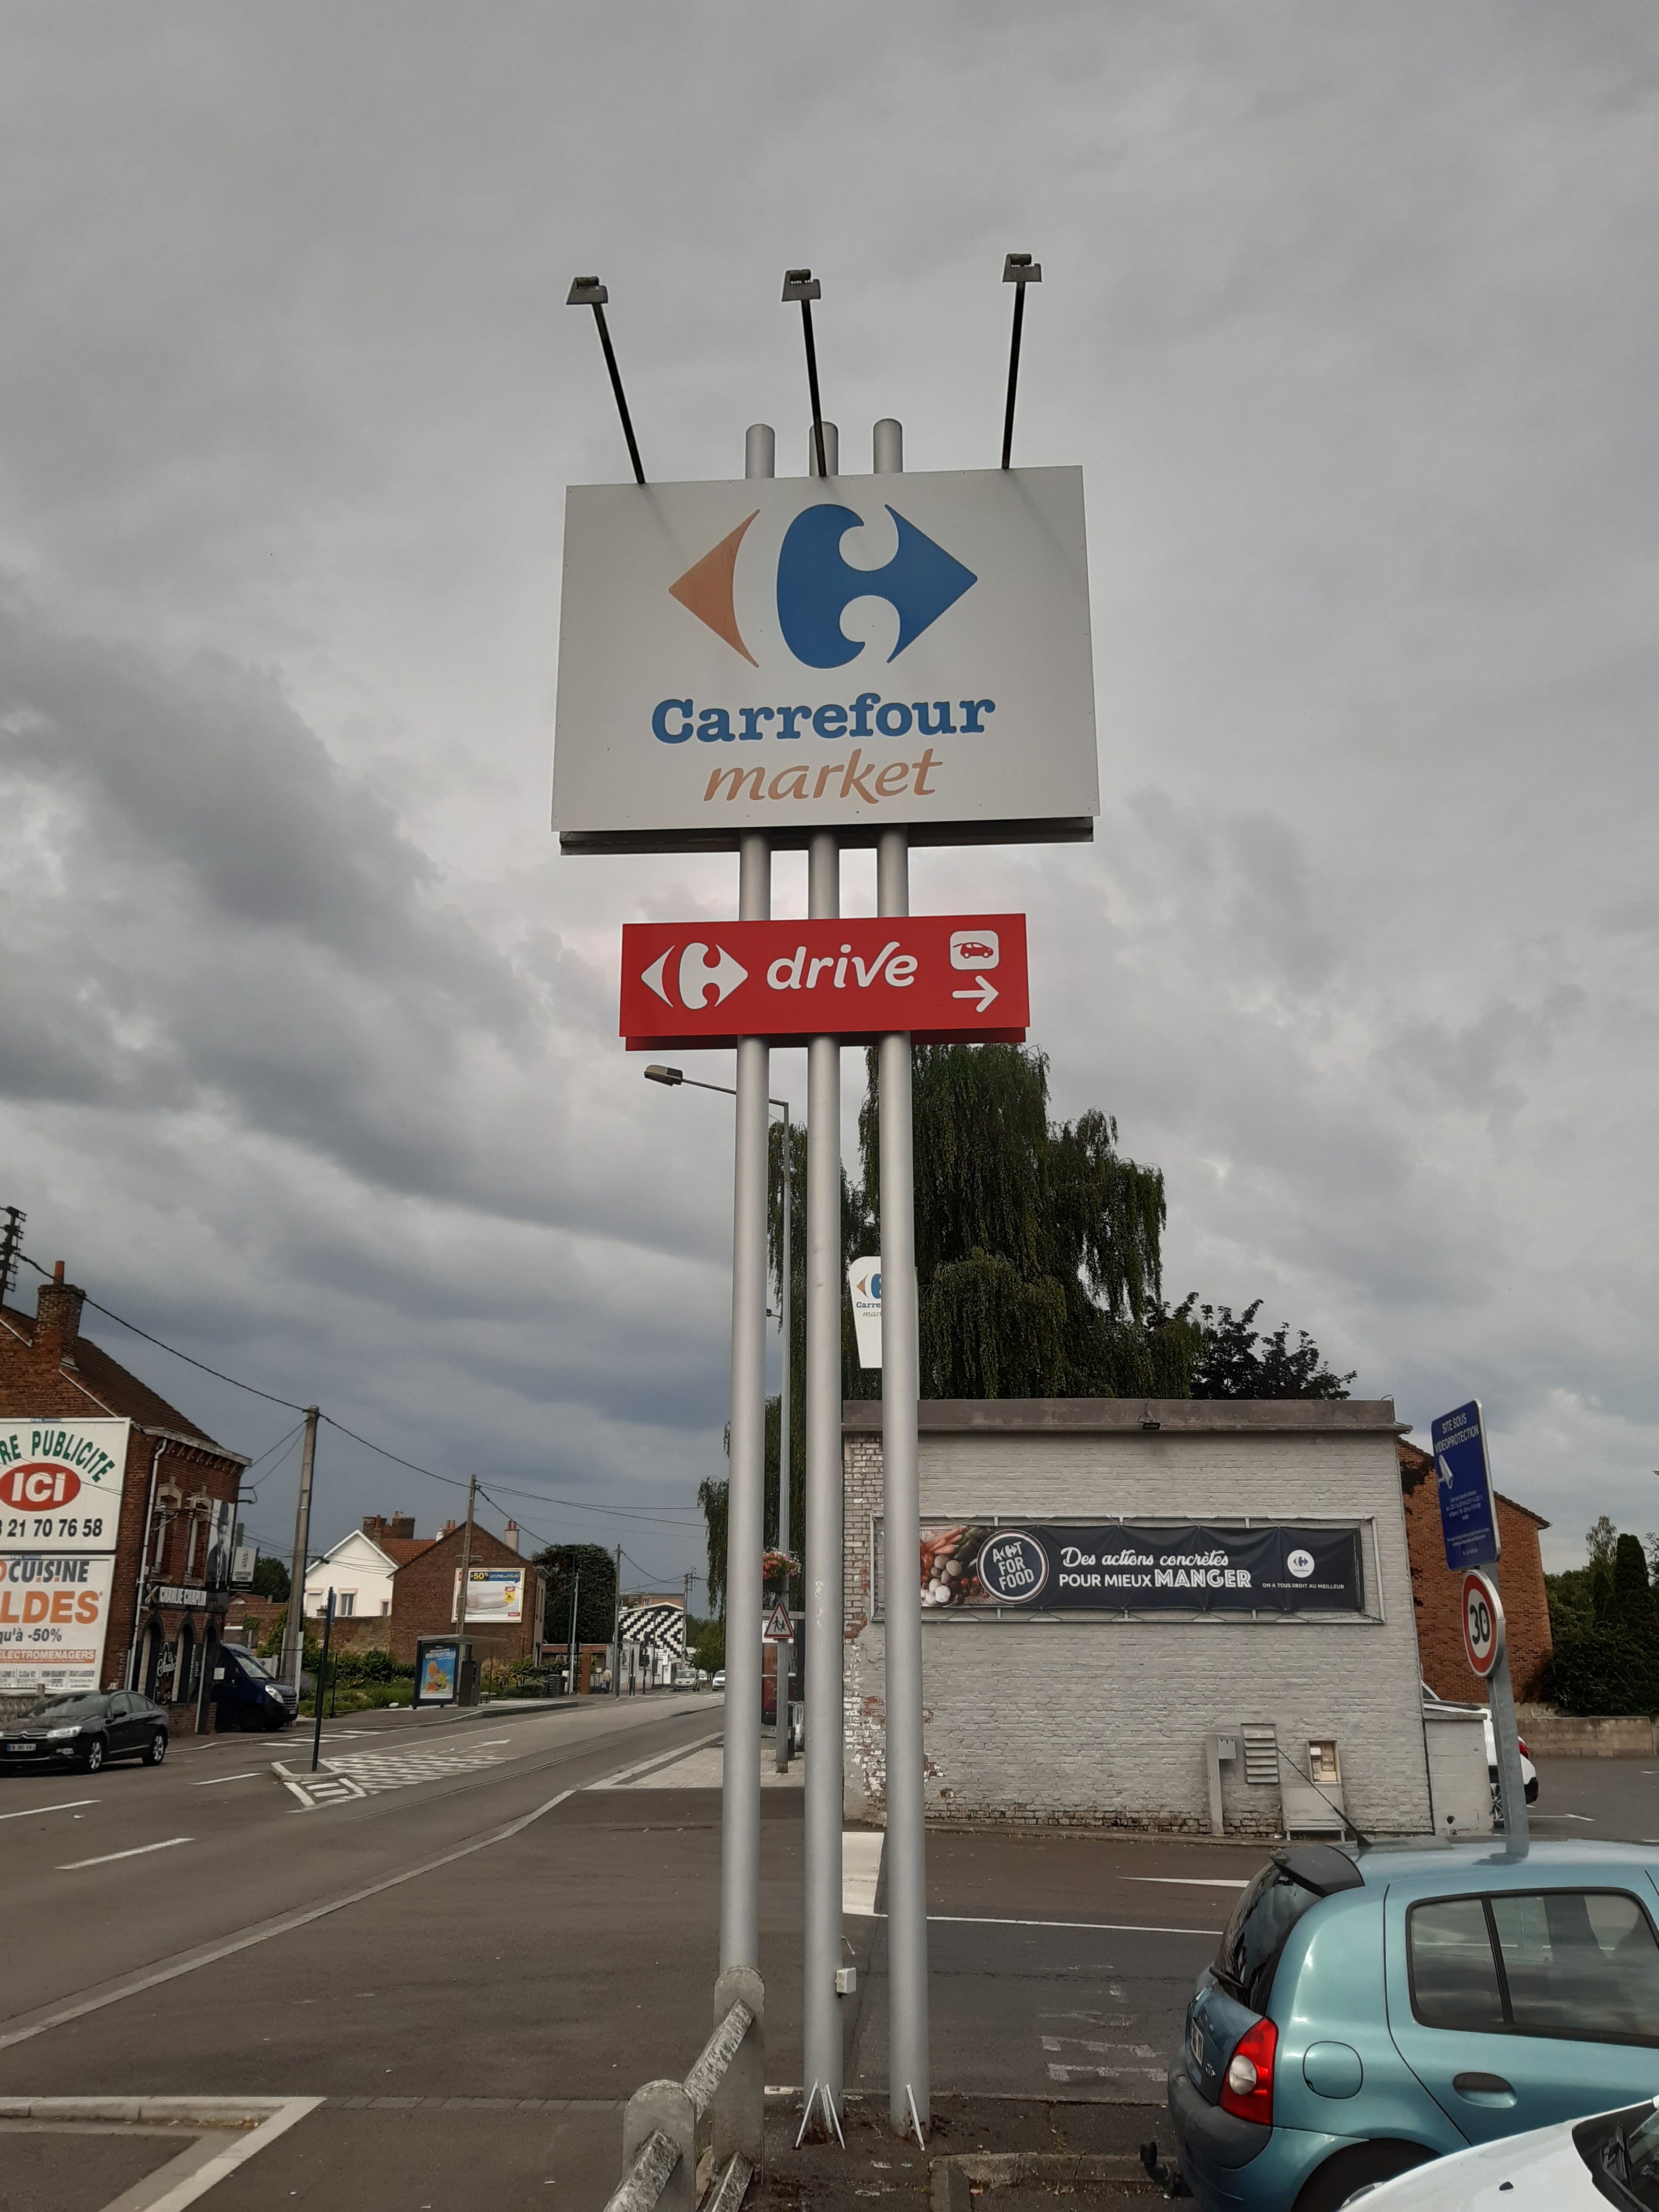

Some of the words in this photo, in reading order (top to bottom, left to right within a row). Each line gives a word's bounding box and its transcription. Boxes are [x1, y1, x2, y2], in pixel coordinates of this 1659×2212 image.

[652, 693, 995, 744] Carrefour
[704, 748, 942, 804] market
[767, 941, 918, 989] drive
[1442, 1419, 1453, 1434] SITE
[1453, 1413, 1467, 1429] SOUS
[1434, 1424, 1479, 1454] VIDEOPROTECTION
[32, 1430, 115, 1483] PUBLICITE
[11, 1472, 66, 1502] ICI
[7, 1518, 26, 1537] 21
[33, 1518, 52, 1537] 70
[58, 1518, 78, 1537] 76
[82, 1518, 103, 1537] 58
[998, 1556, 1026, 1575] FOR
[1060, 1547, 1096, 1567] Des
[1102, 1549, 1154, 1566] actions
[1159, 1550, 1229, 1566] concrètes
[998, 1569, 1034, 1591] FOOD
[1059, 1574, 1102, 1587] POUR
[1105, 1574, 1153, 1587] MIEUX
[1154, 1569, 1252, 1587] MANGER
[1470, 1601, 1490, 1645] 30
[28, 1628, 62, 1642] -50%
[0, 1650, 95, 1659] LECTROMENAGERS
